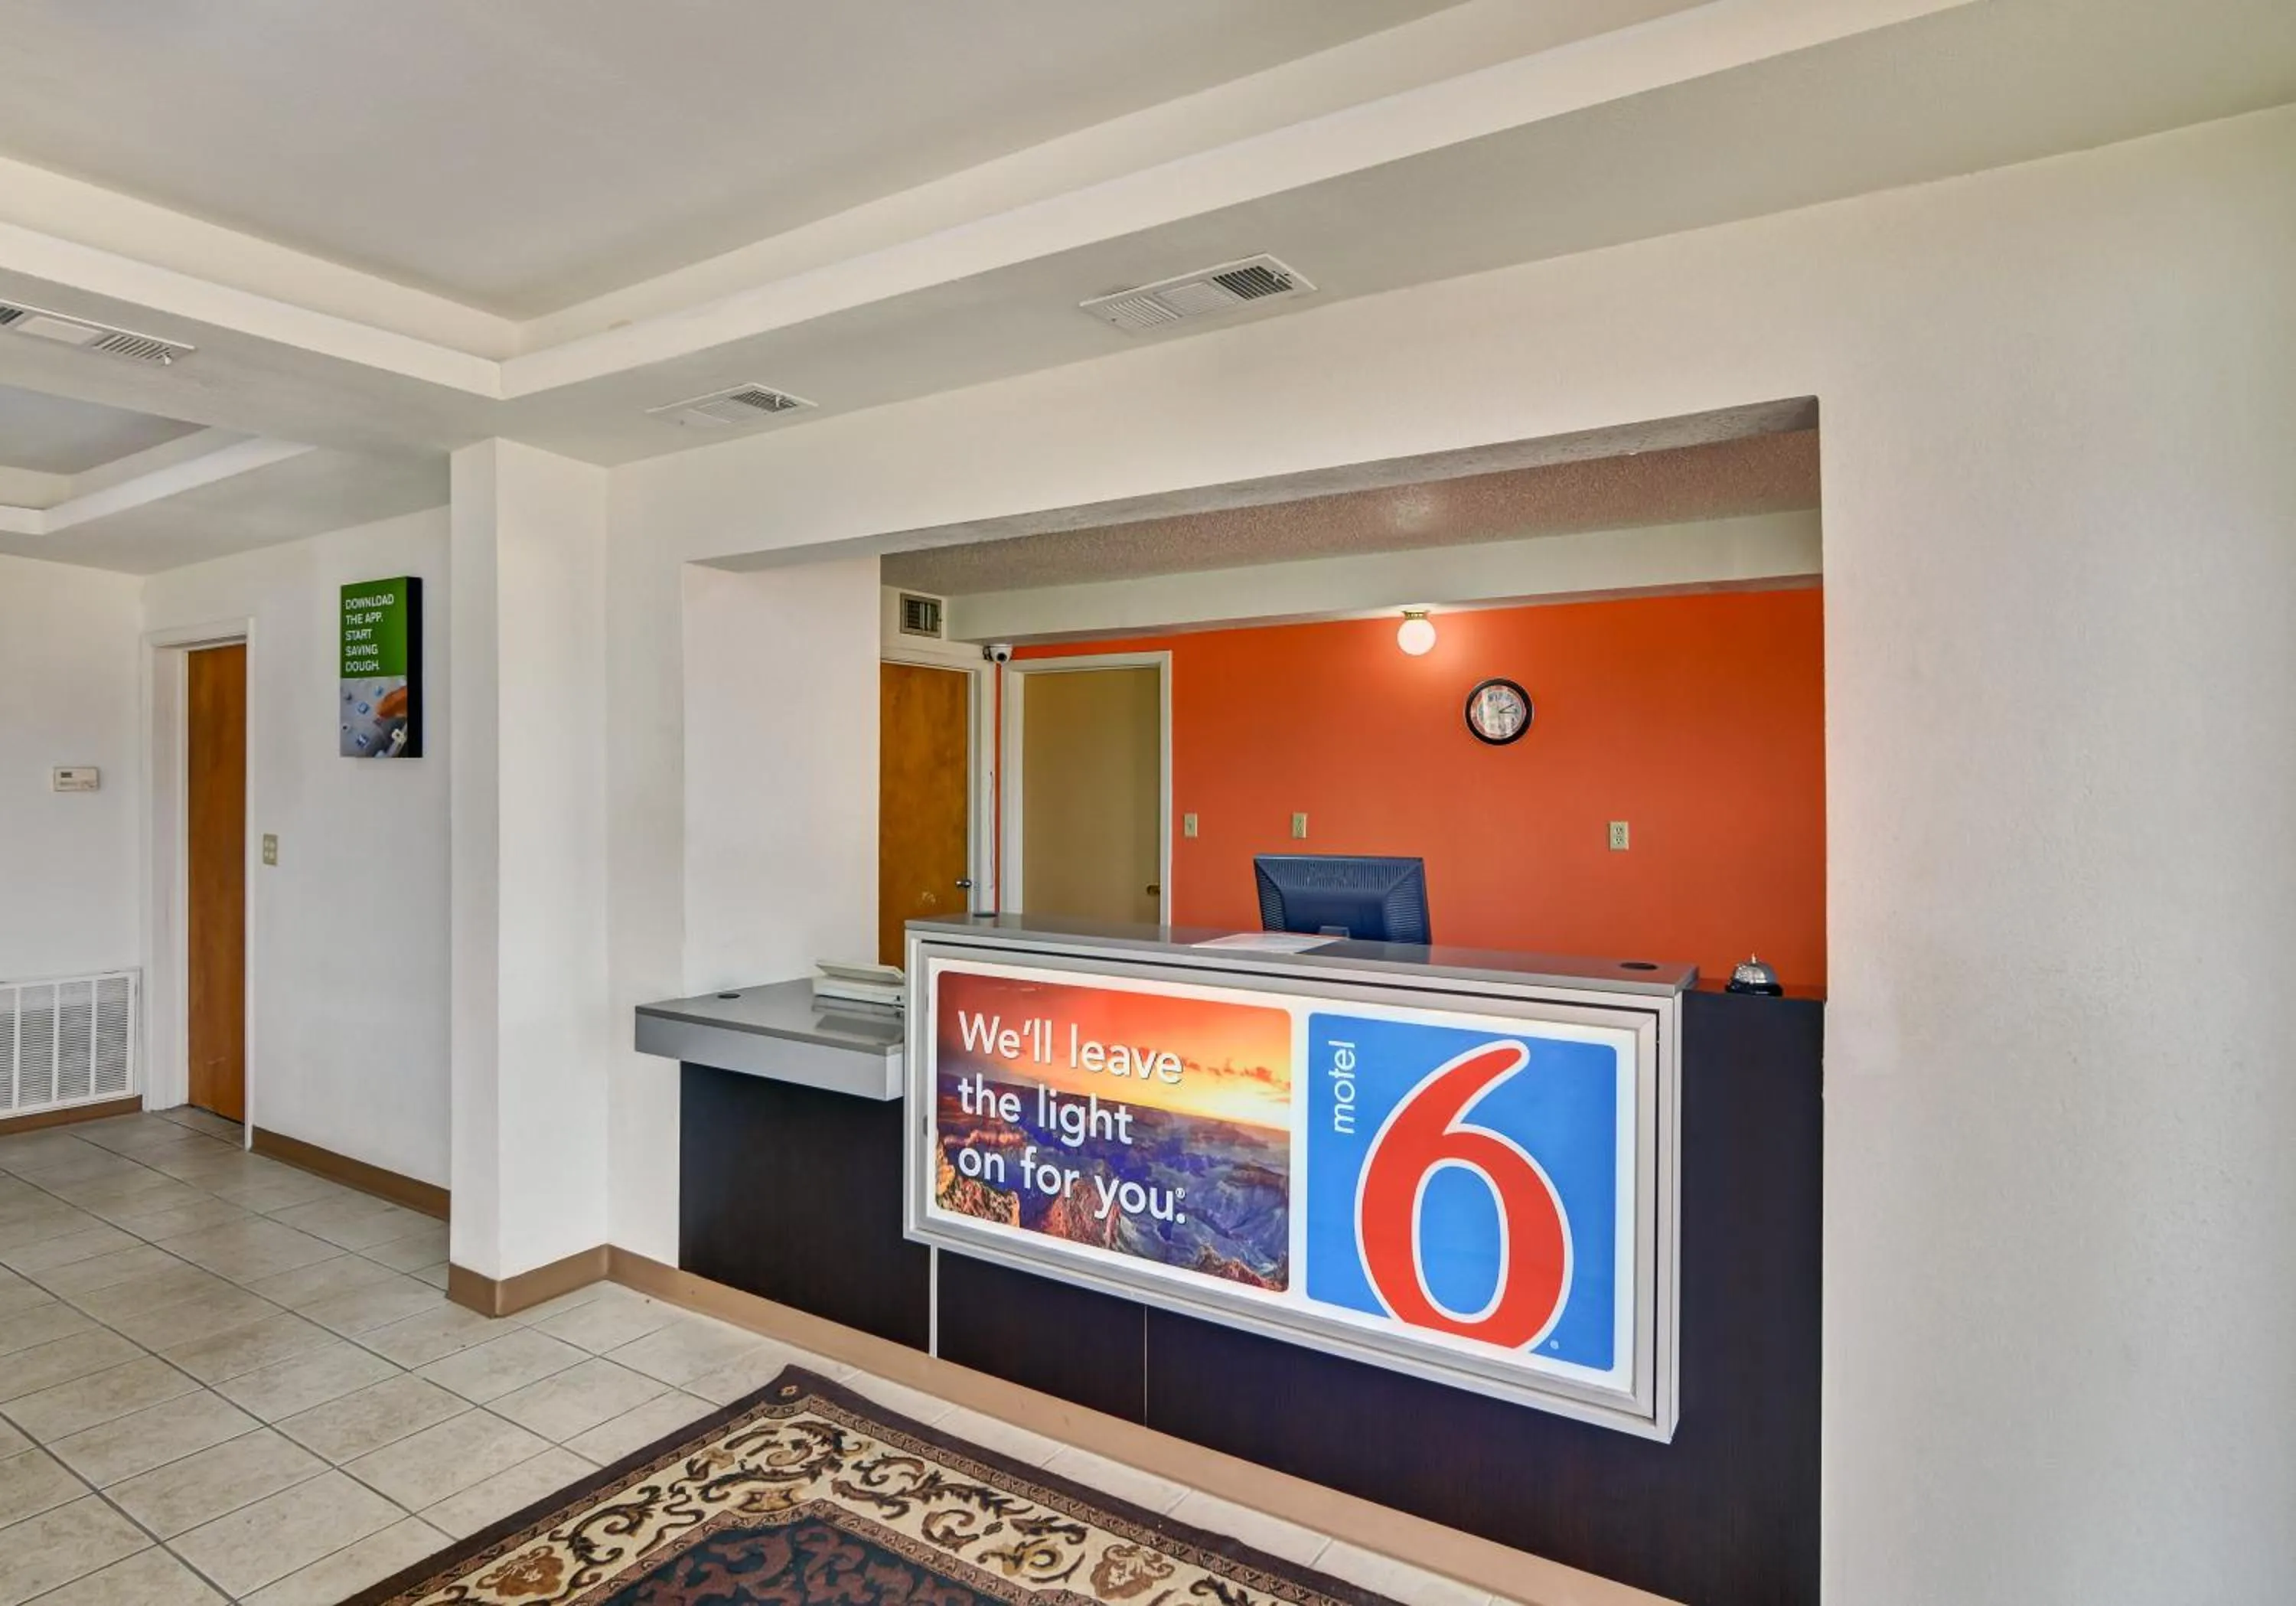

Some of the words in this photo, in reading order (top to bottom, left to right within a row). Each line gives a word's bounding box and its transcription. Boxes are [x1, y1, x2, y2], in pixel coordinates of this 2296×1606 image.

[345, 593, 394, 610] DOWNLOAD
[345, 613, 364, 625] THE
[345, 628, 373, 641] START
[345, 644, 379, 656] SAVING
[958, 1010, 1052, 1065] We'll
[1070, 1023, 1184, 1084] leave
[957, 1073, 1021, 1123] the
[1038, 1084, 1133, 1147] light
[1328, 1040, 1355, 1134] motel
[958, 1148, 1005, 1183] on
[1020, 1146, 1080, 1199] for
[1354, 1039, 1574, 1353] 6
